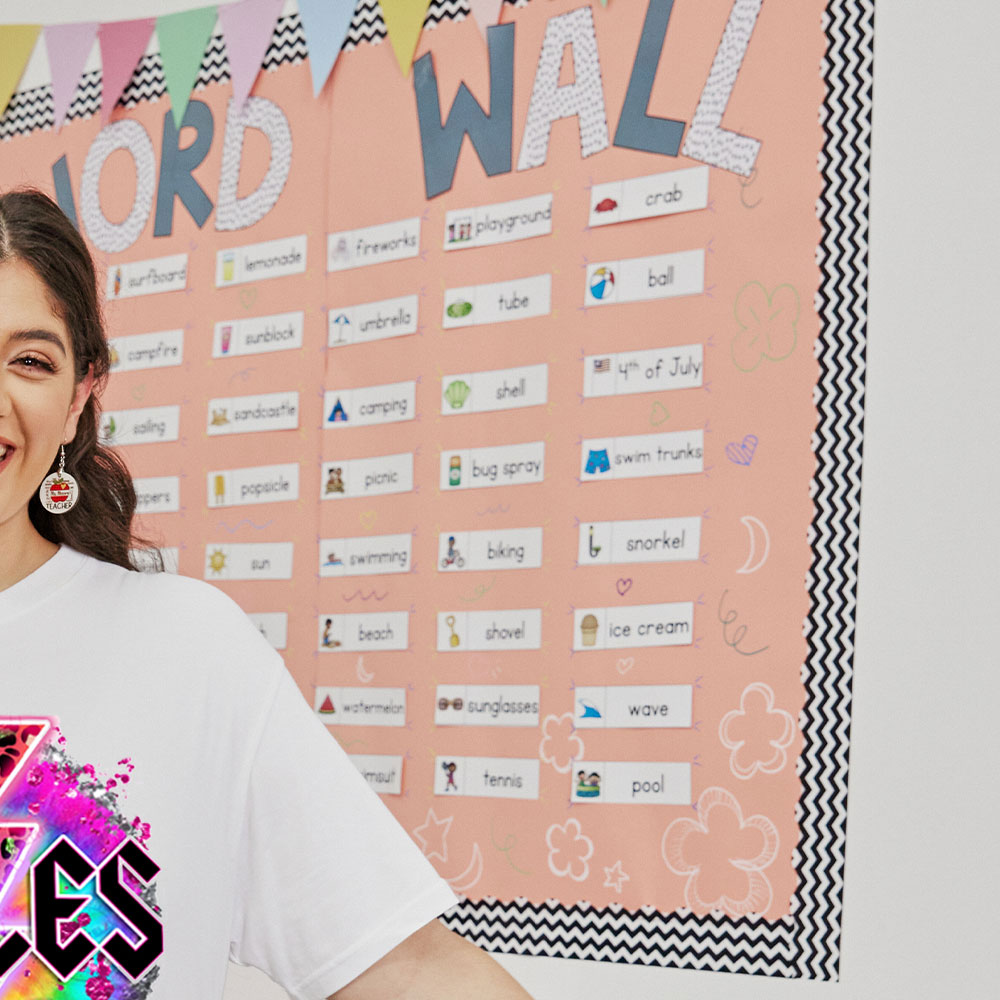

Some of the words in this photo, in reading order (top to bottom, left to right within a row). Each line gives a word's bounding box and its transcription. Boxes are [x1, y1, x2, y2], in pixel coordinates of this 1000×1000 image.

[52, 99, 293, 253] ORD
[413, 0, 763, 200] WALL
[645, 187, 683, 208] crab
[475, 207, 552, 238] playground
[356, 232, 417, 257] fireworks
[244, 250, 302, 273] lemonade
[128, 268, 187, 289] surfboard
[648, 266, 674, 288] ball
[499, 292, 529, 310] tube
[360, 311, 412, 333] umbrella
[244, 325, 296, 345] sunblock
[128, 344, 179, 363] campfire
[644, 358, 664, 380] of
[669, 357, 702, 379] July
[496, 378, 526, 401] shell
[234, 402, 297, 421] sandcastle
[359, 397, 408, 417] camping
[133, 418, 167, 436] sailing
[614, 450, 651, 466] swim
[656, 447, 703, 463] trunks
[364, 470, 398, 488] picnic
[472, 461, 498, 481] bug
[502, 459, 541, 479] spray
[240, 477, 290, 497] popsicle
[46, 502, 72, 510] TEACHER
[136, 492, 171, 505] ppers
[626, 530, 686, 552] snorkel
[349, 549, 408, 567] swimming
[487, 541, 525, 562] biking
[251, 557, 271, 571] sun
[358, 628, 394, 642] beach
[485, 621, 525, 641] shovel
[609, 623, 631, 637] ice
[638, 619, 689, 636] cream
[342, 699, 404, 714] watermelon
[467, 695, 539, 718] sunglasses
[628, 703, 669, 716] wave
[483, 773, 523, 789] tennis
[632, 773, 665, 797] pool
